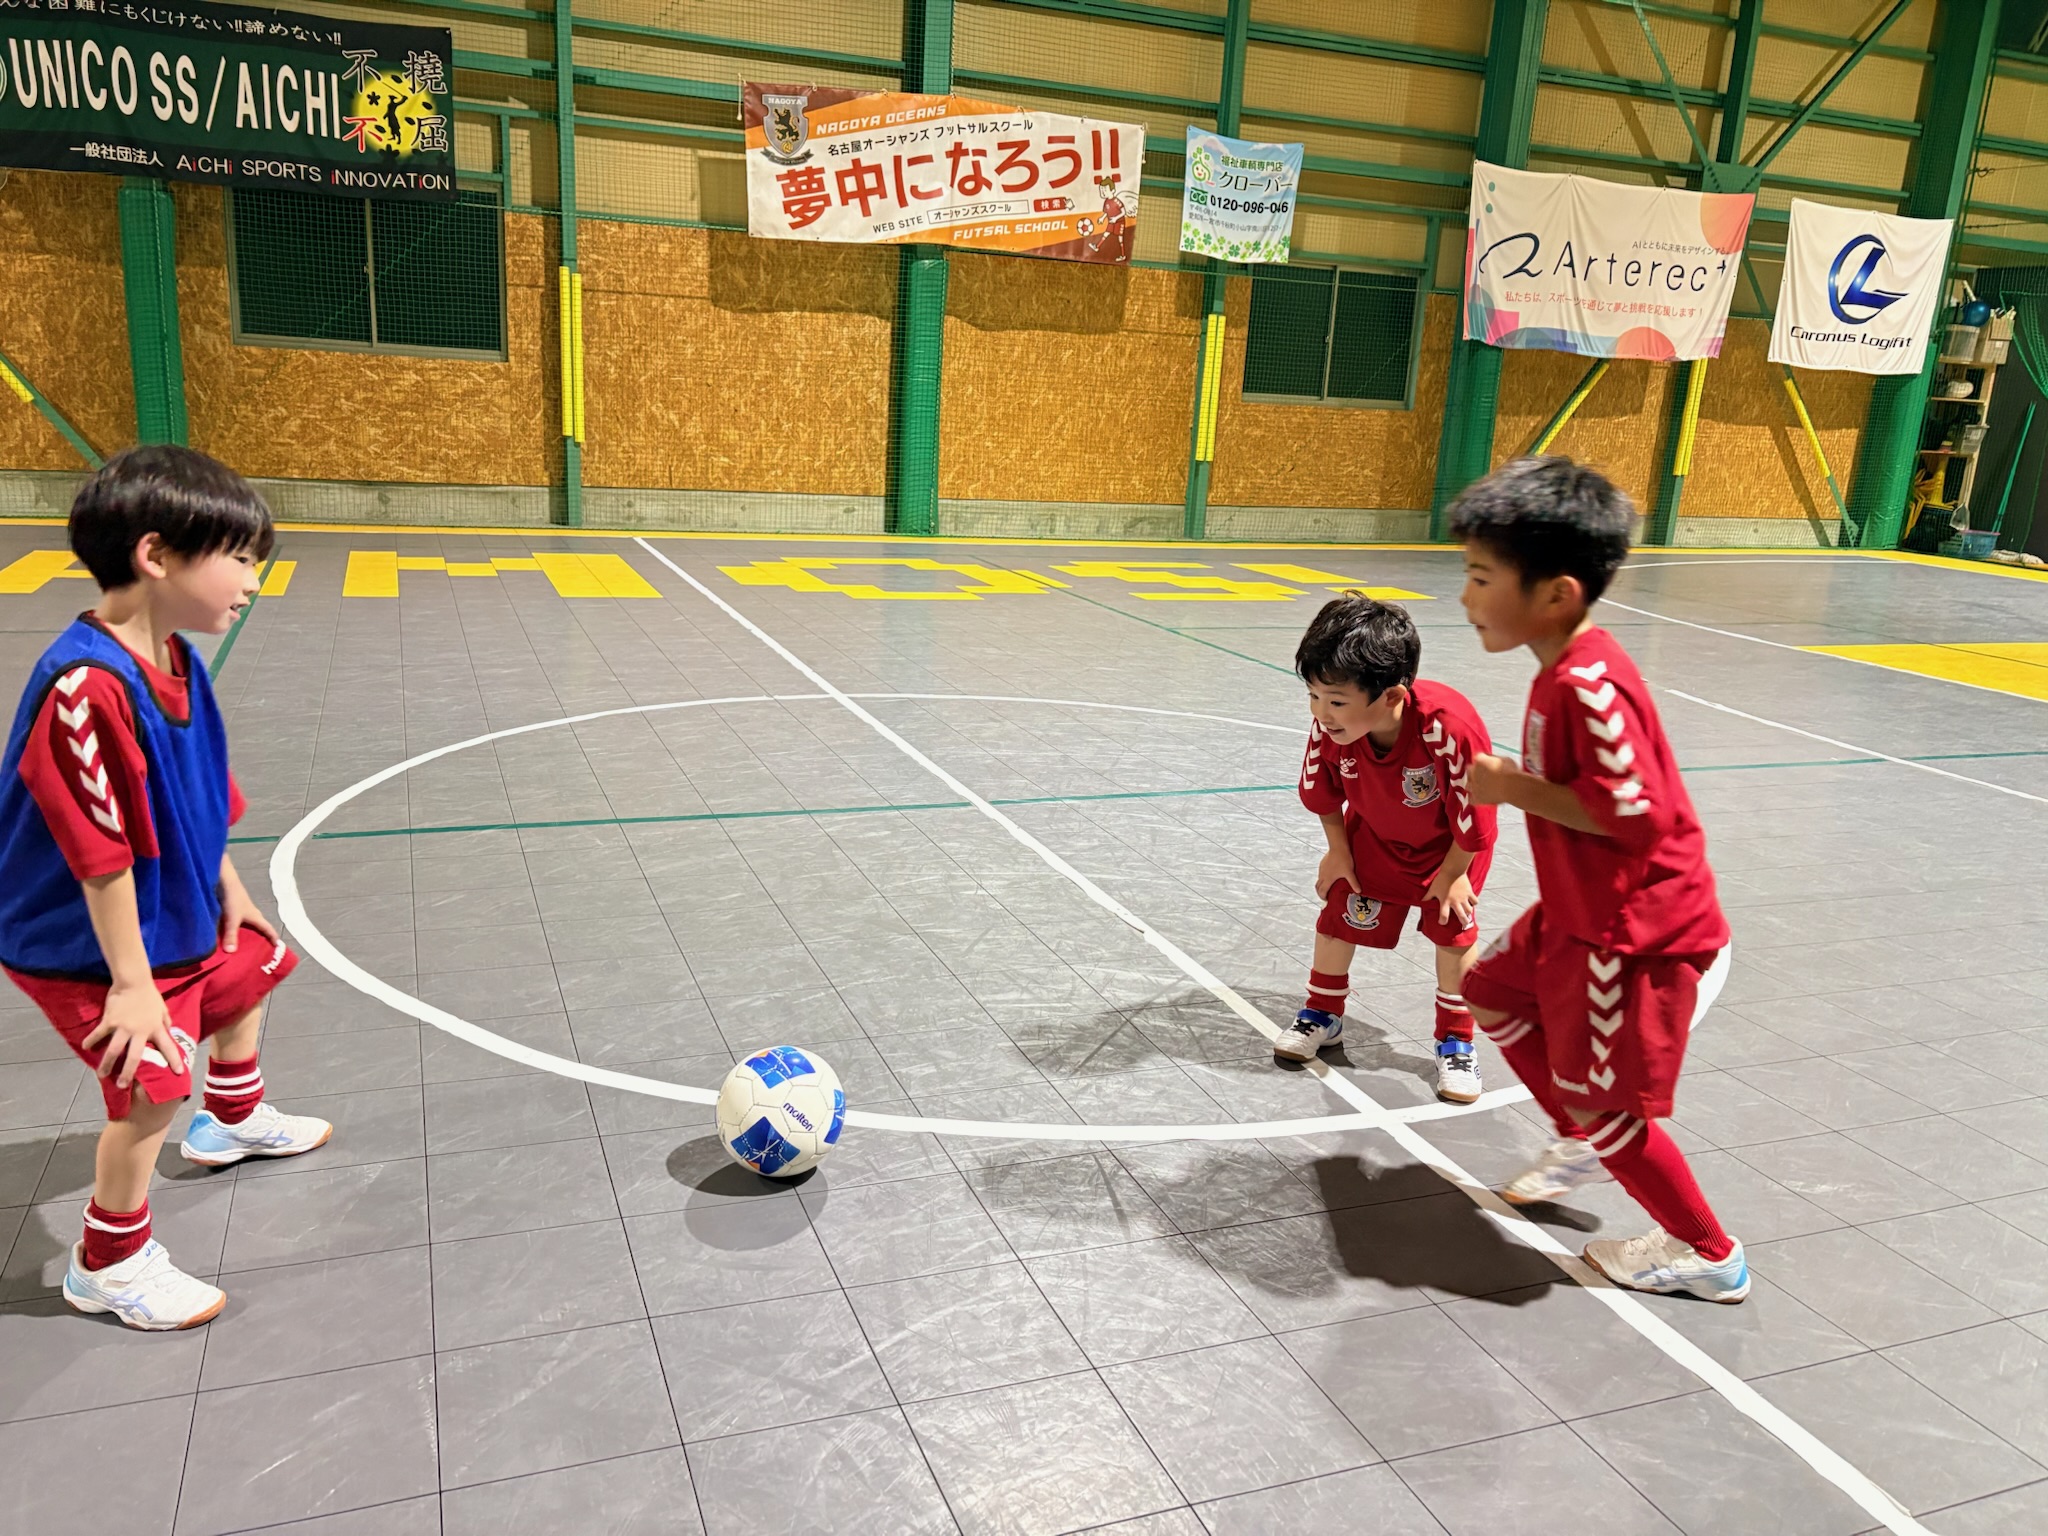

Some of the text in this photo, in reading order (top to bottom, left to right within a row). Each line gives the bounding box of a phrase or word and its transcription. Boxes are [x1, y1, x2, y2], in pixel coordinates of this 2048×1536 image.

[8, 38, 138, 116] UNICO
[768, 97, 802, 105] NAGOYA
[816, 104, 947, 135] NAGOYA OCEANS
[828, 119, 1033, 157] 名古屋オーシャンズ フットサルスクール
[70, 141, 164, 168] 一般社団法人
[241, 159, 322, 182] SPORTS
[1219, 171, 1293, 192] クローバー
[1040, 199, 1061, 210] 検索
[873, 215, 923, 233] WEB SITE
[954, 220, 1069, 240] FUTSAL SCHOOL
[783, 1103, 813, 1131] molten
